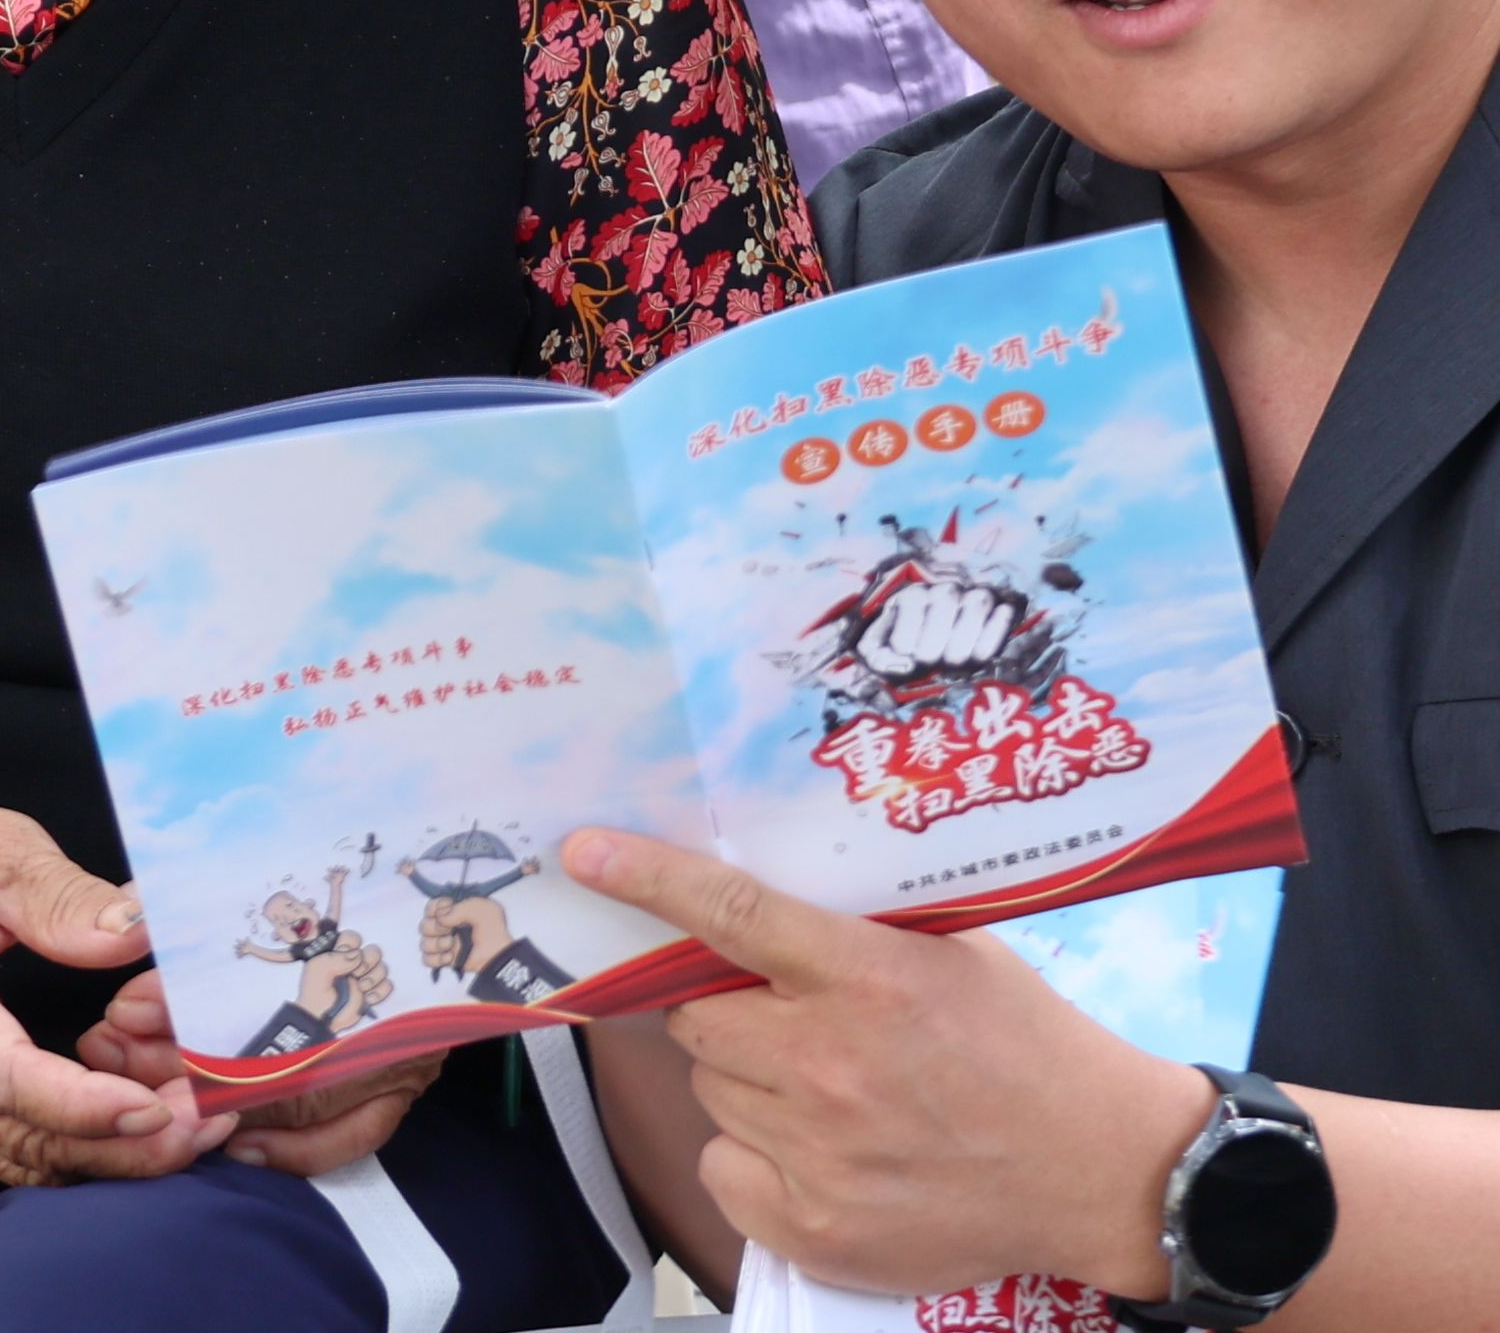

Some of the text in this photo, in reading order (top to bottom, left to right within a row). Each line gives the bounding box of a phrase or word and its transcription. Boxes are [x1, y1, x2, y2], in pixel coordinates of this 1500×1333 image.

[688, 320, 1122, 457] 深化扫黑除恶专项斗争
[792, 397, 1035, 479] 宣传手册
[181, 635, 473, 717] 深化扫黑除恶专项斗争
[282, 664, 582, 736] 弘扬正气维护社会稳定
[819, 682, 1106, 797] 重拳出击
[892, 724, 1144, 827] 扫黑除恶
[897, 823, 1124, 893] 中共永城市委政法委员会
[922, 1274, 1113, 1333] 扫黑除恶
